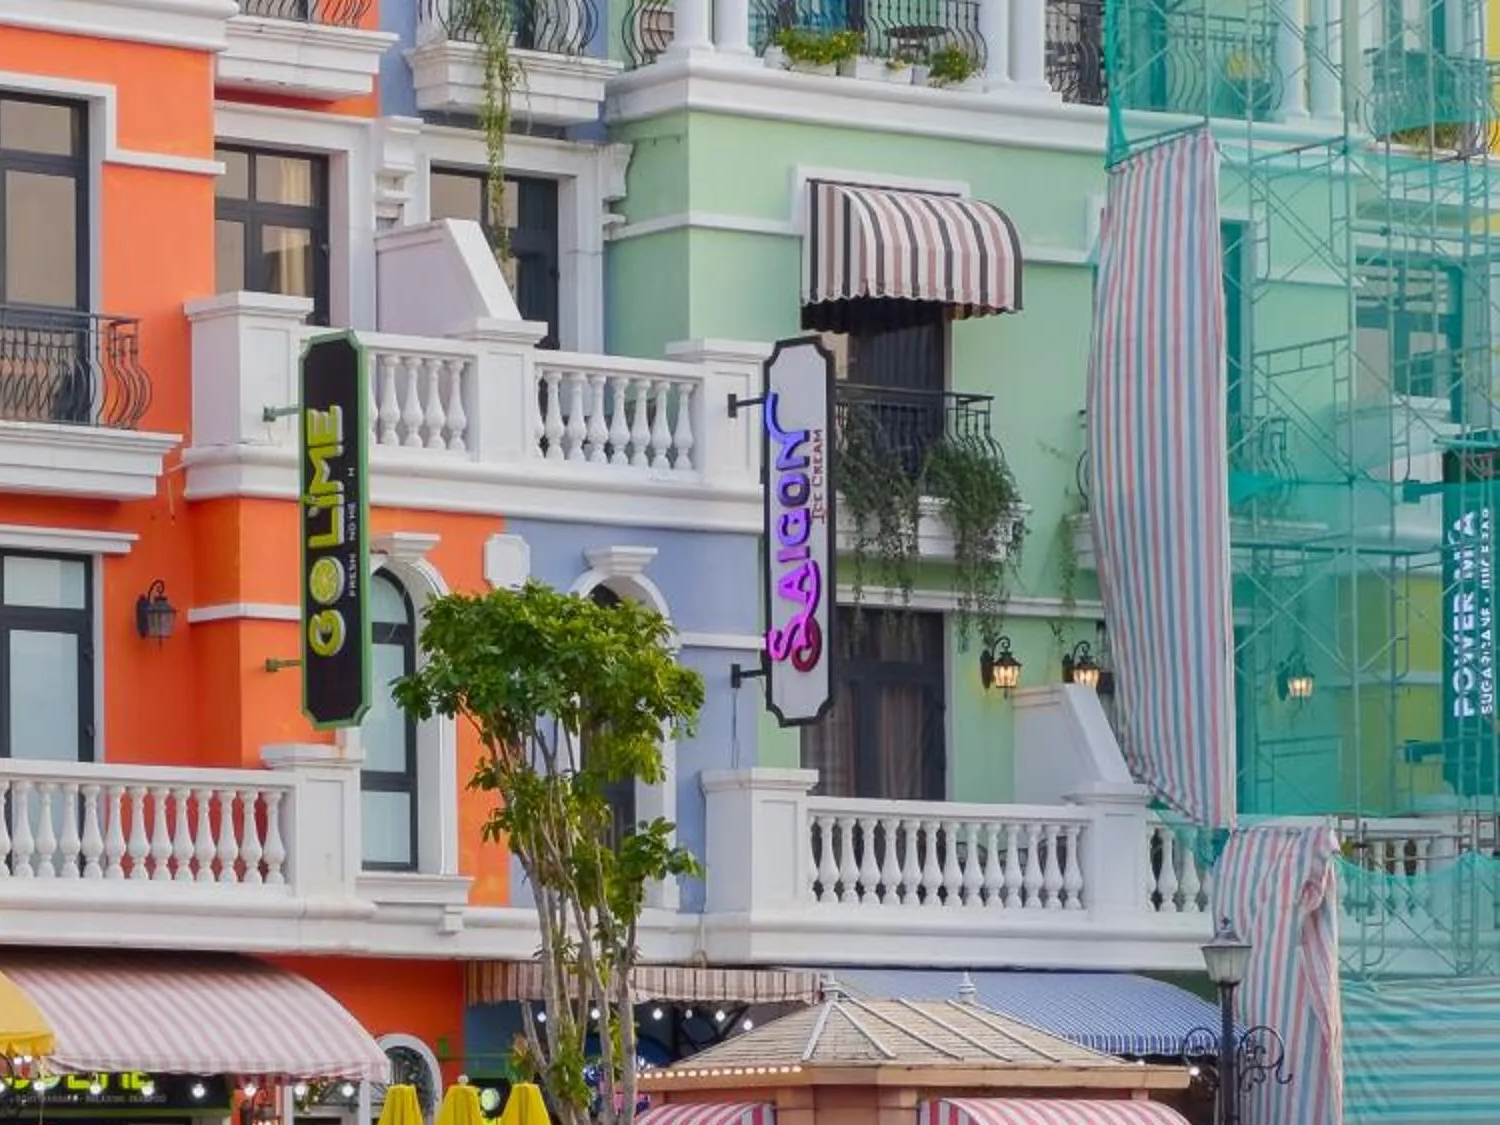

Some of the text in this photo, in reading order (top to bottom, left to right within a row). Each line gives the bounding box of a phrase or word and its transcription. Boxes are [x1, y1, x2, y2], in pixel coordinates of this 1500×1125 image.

[811, 429, 824, 488] CREAM
[763, 393, 822, 672] SAIGON
[1453, 591, 1476, 718] POWER
